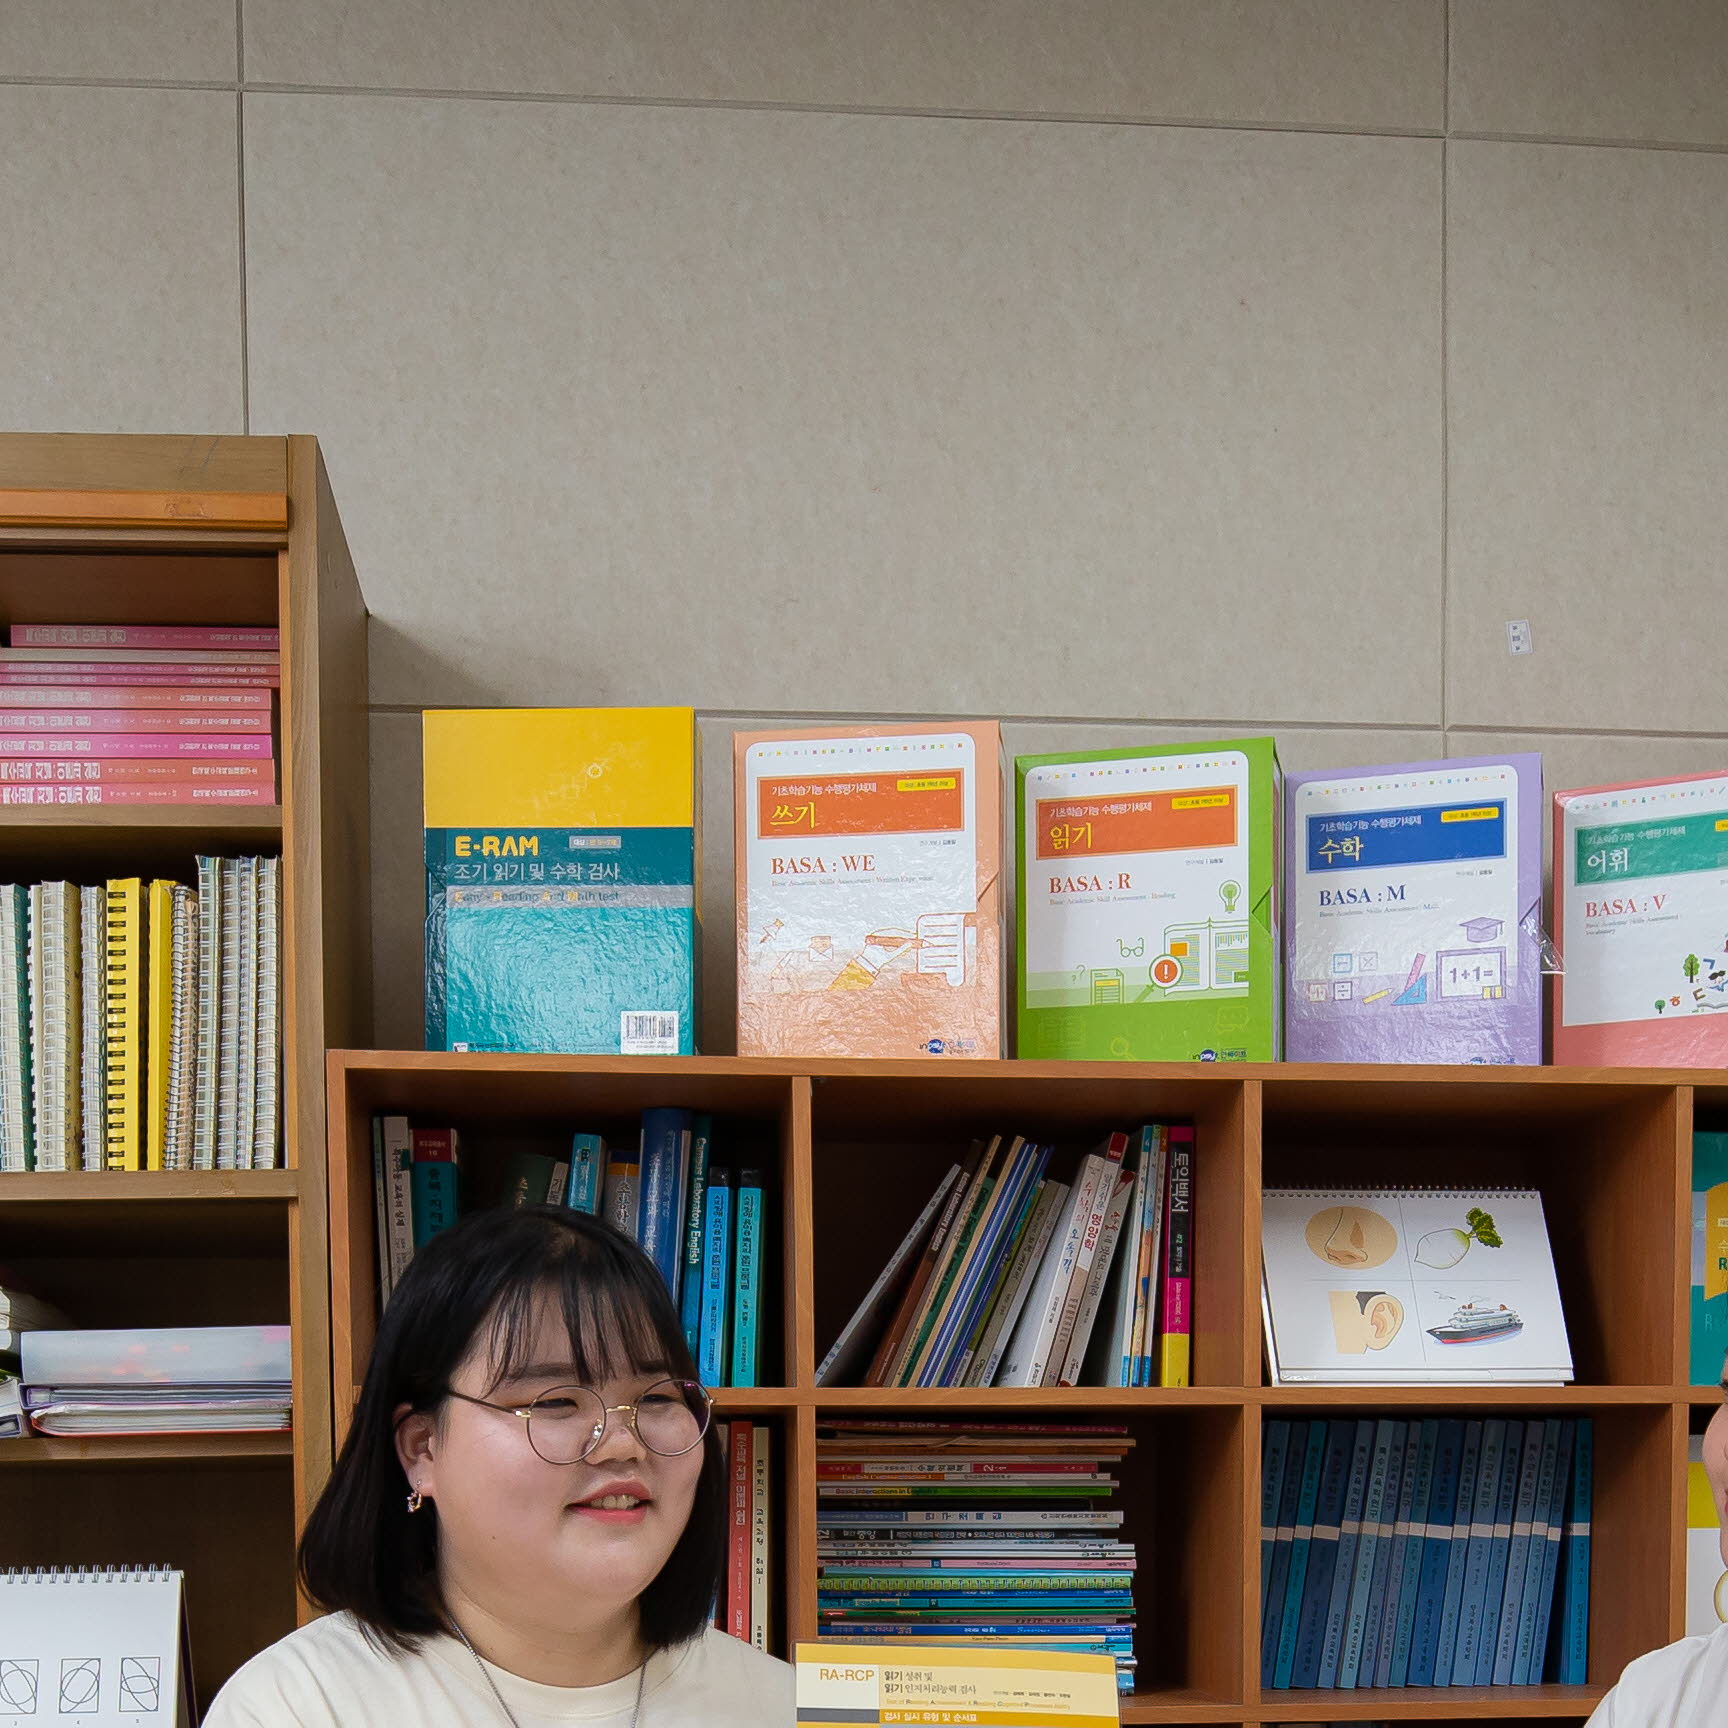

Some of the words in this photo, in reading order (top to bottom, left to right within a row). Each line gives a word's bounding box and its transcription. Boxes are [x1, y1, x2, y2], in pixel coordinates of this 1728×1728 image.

[771, 785, 822, 796] 기초학습기능
[770, 801, 815, 828] 쓰기
[1050, 808, 1099, 817] 기초학습기능
[1102, 801, 1152, 814] 수행평가체제
[1320, 823, 1368, 832] 기초학습기능
[1371, 815, 1421, 829] 수행평가체제
[455, 835, 539, 857] E-RAM
[1051, 823, 1092, 850] 읽기
[1318, 836, 1364, 864] 수학
[771, 857, 826, 874] BASA
[842, 855, 875, 872] WE
[1588, 848, 1629, 873] 어휘
[455, 863, 487, 880] 조기
[493, 863, 523, 880] 읽기
[530, 863, 544, 880] 및
[550, 863, 581, 880] 수학
[589, 863, 620, 879] 검사
[1049, 875, 1102, 893] BASA
[1117, 873, 1131, 889] R
[599, 891, 619, 901] test
[1320, 888, 1371, 906] BASA
[1387, 884, 1406, 901] M
[1585, 899, 1637, 918] BASA
[1653, 895, 1667, 911] V
[1170, 1152, 1190, 1212] 토익백서
[688, 1229, 701, 1265] English
[819, 1669, 874, 1681] RA-RCP
[884, 1671, 903, 1681] 읽기
[905, 1671, 922, 1682] 성취
[923, 1671, 933, 1681] 및
[884, 1683, 903, 1693] 읽기
[960, 1685, 976, 1694] 검사
[884, 1712, 900, 1721] 검사
[904, 1712, 920, 1721] 실시
[923, 1712, 939, 1721] 유형
[943, 1713, 950, 1722] 및
[953, 1713, 976, 1722] 순서표
